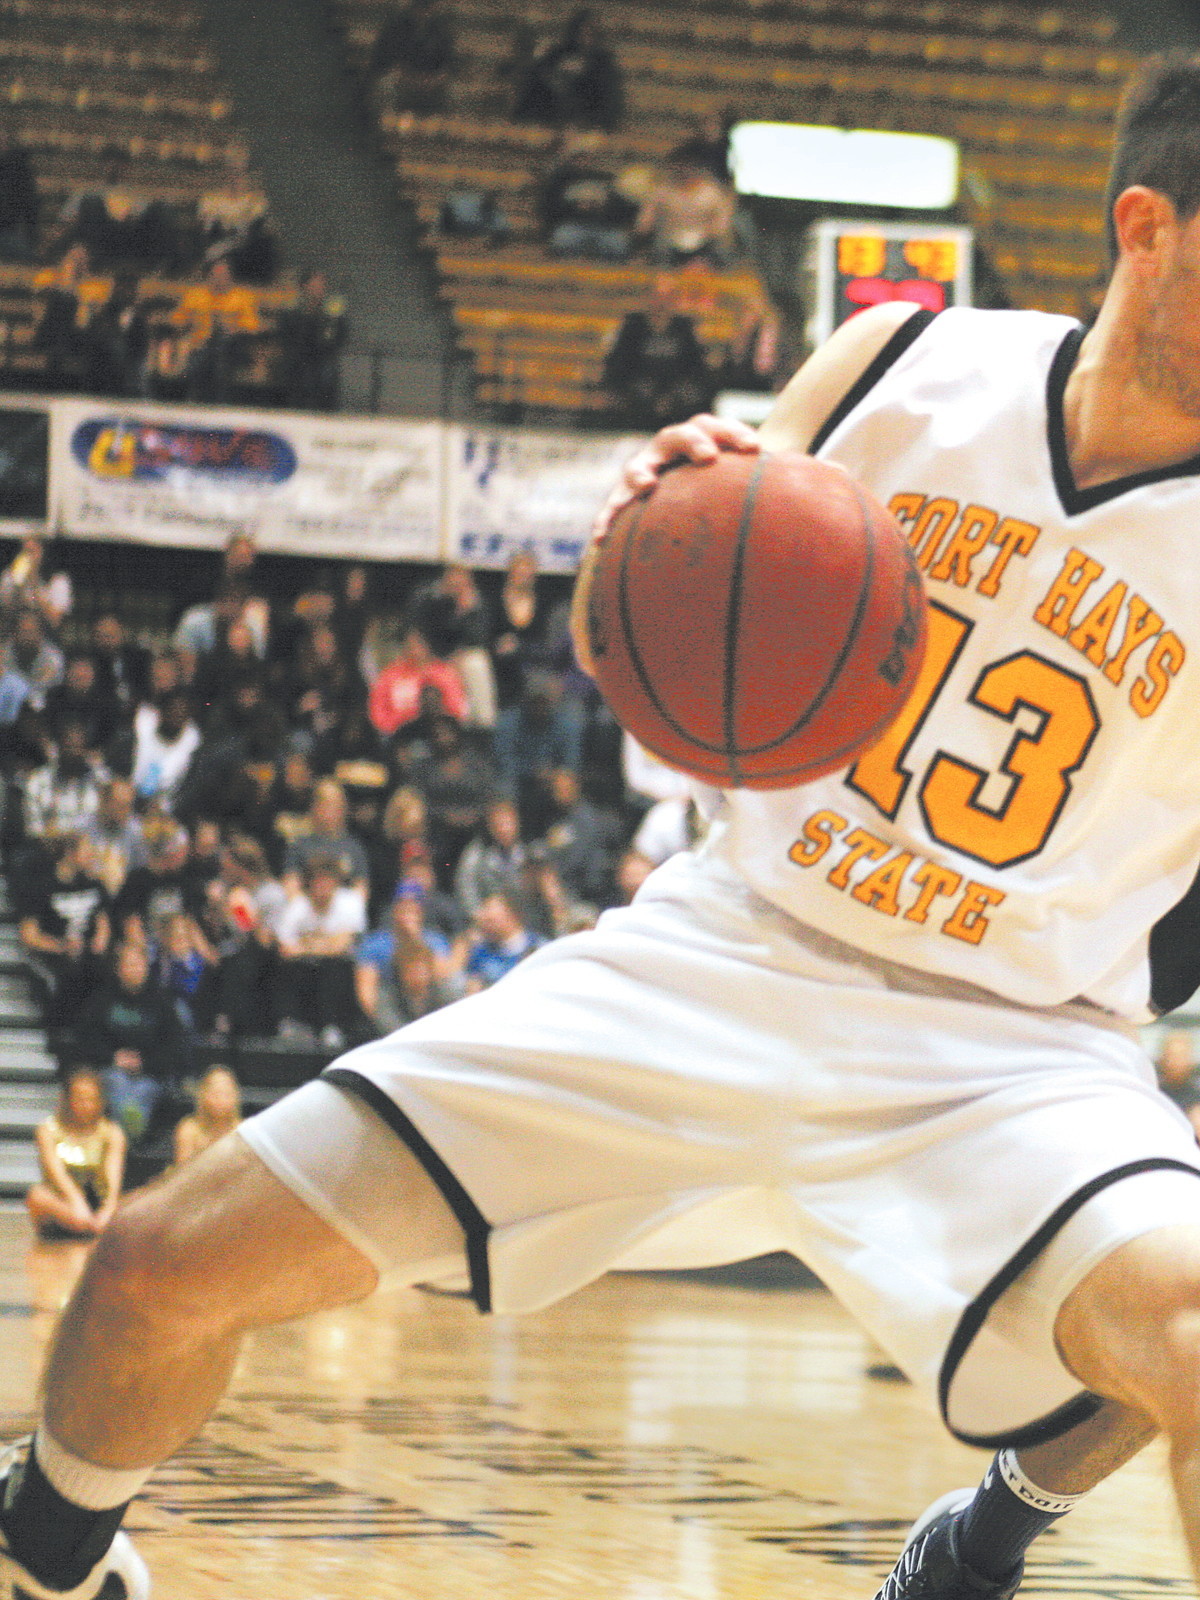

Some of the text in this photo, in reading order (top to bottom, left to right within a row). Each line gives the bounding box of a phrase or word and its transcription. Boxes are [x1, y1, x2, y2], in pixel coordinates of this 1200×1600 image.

[1033, 546, 1187, 719] HAYS
[843, 596, 1101, 871] 13
[788, 808, 1007, 945] STATE
